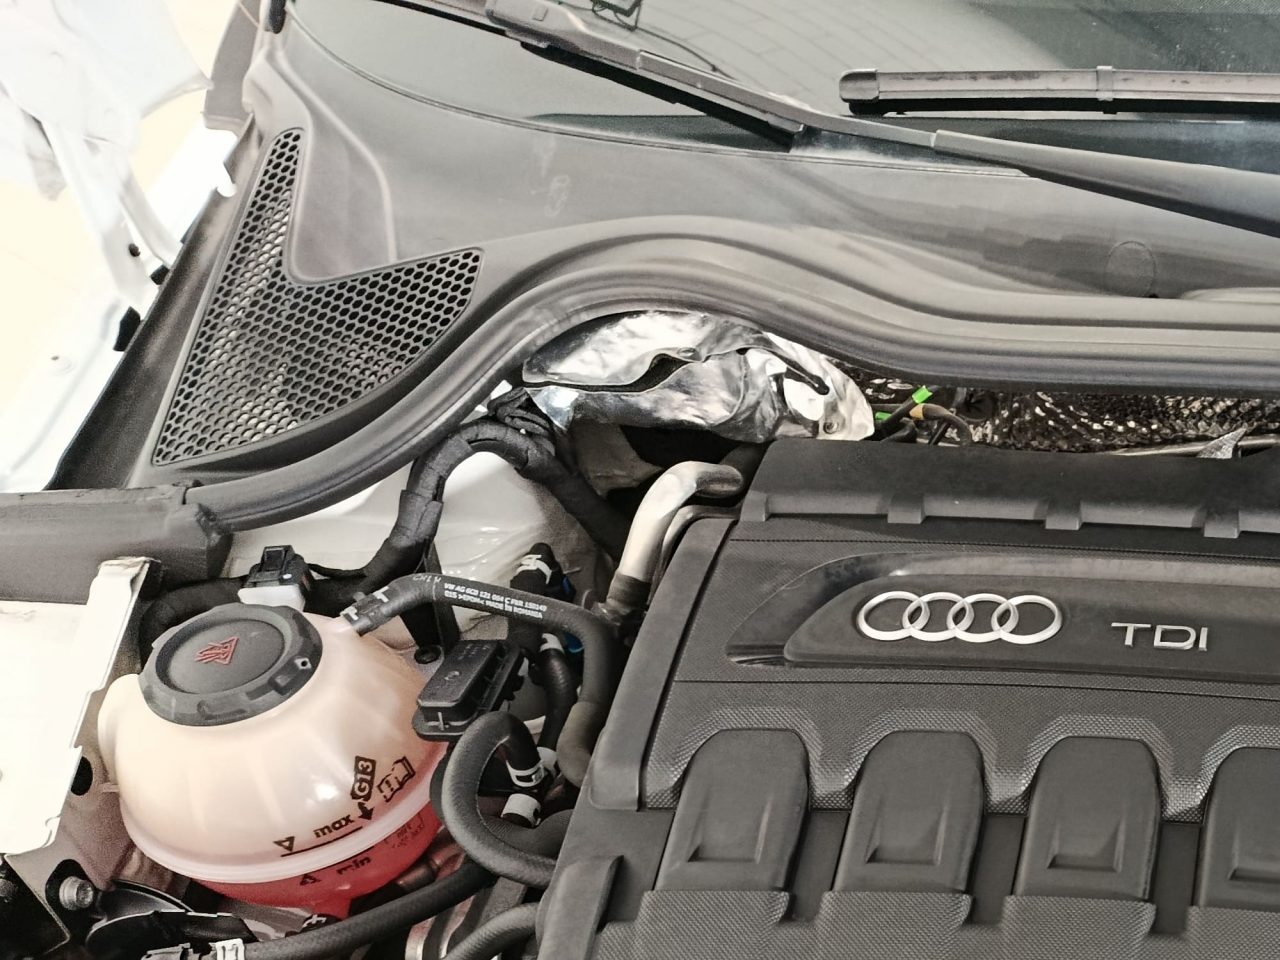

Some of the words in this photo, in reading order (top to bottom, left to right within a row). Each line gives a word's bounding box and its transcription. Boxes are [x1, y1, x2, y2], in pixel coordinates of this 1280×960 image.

[1111, 622, 1209, 651] TDI
[354, 759, 373, 797] G13
[313, 814, 356, 839] max
[337, 856, 372, 875] min
